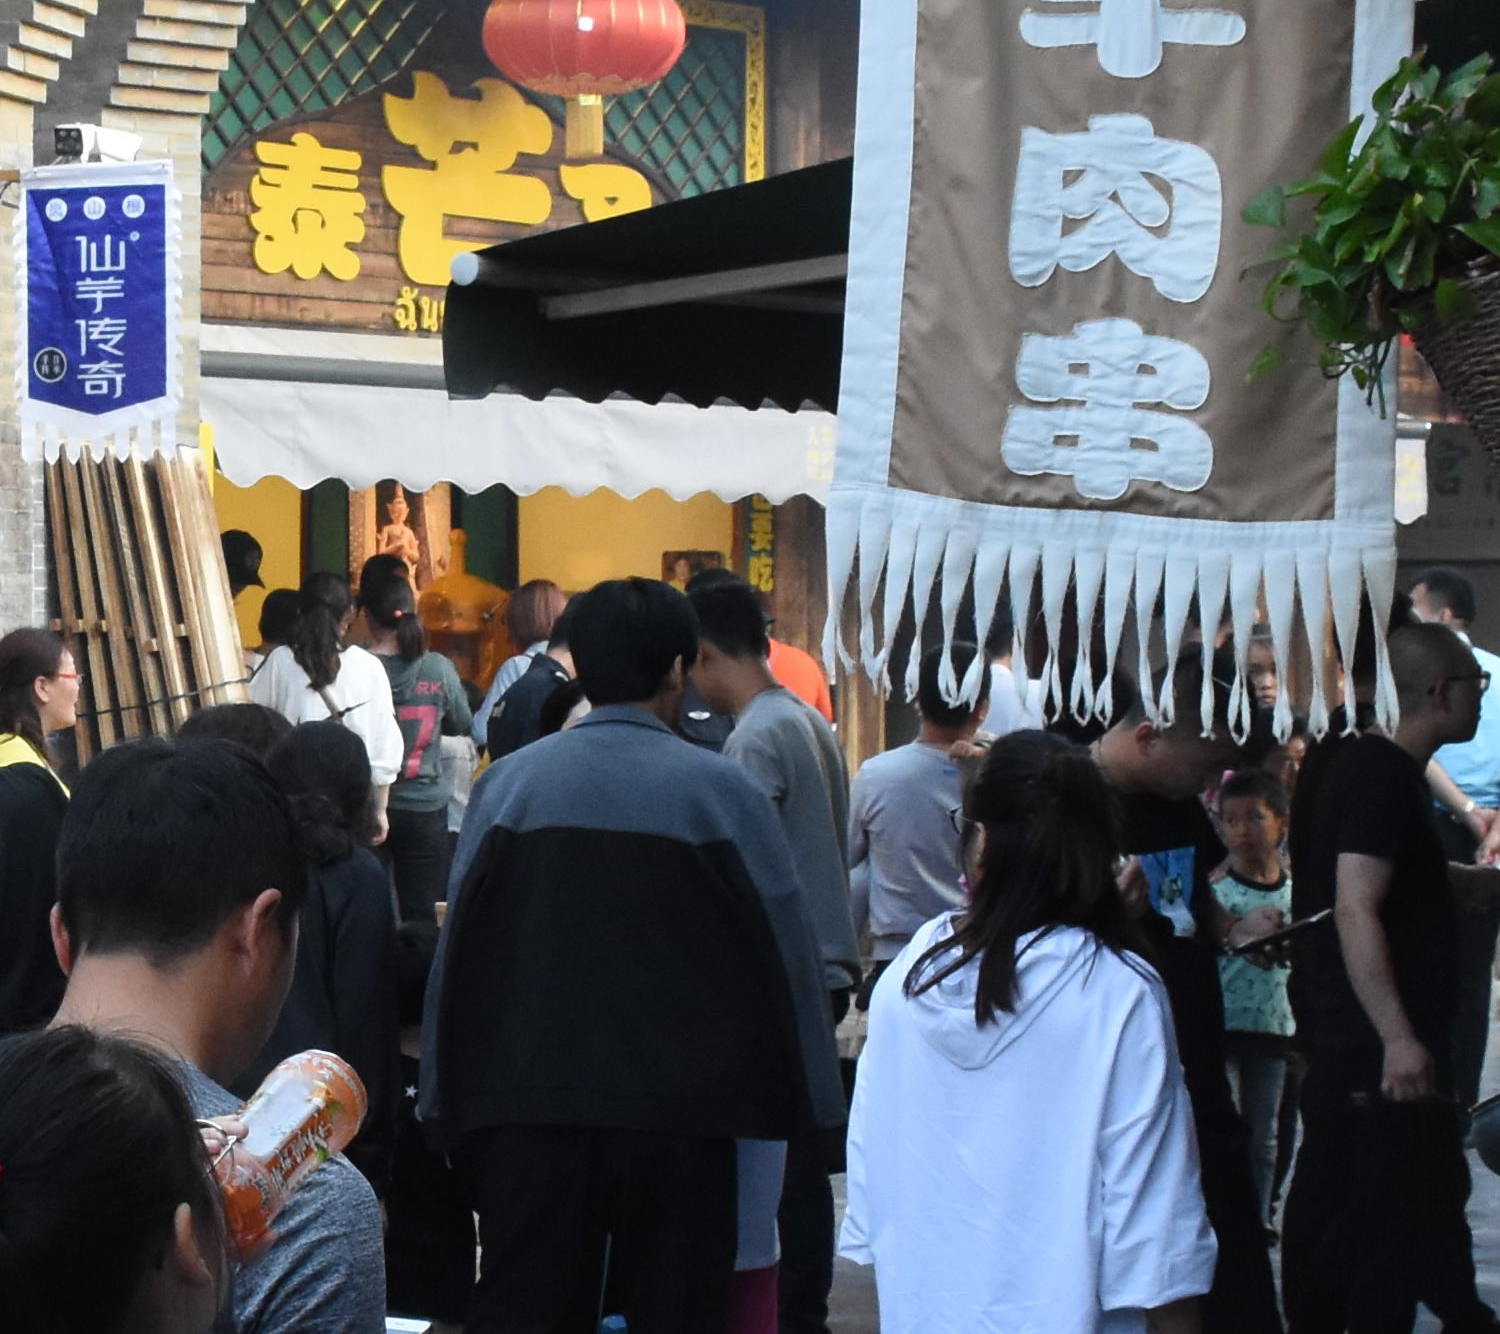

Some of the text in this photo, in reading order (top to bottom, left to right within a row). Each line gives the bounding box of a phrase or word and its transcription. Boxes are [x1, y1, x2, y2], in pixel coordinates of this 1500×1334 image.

[75, 234, 127, 399] 仙芋传奇
[397, 704, 438, 780] 7
